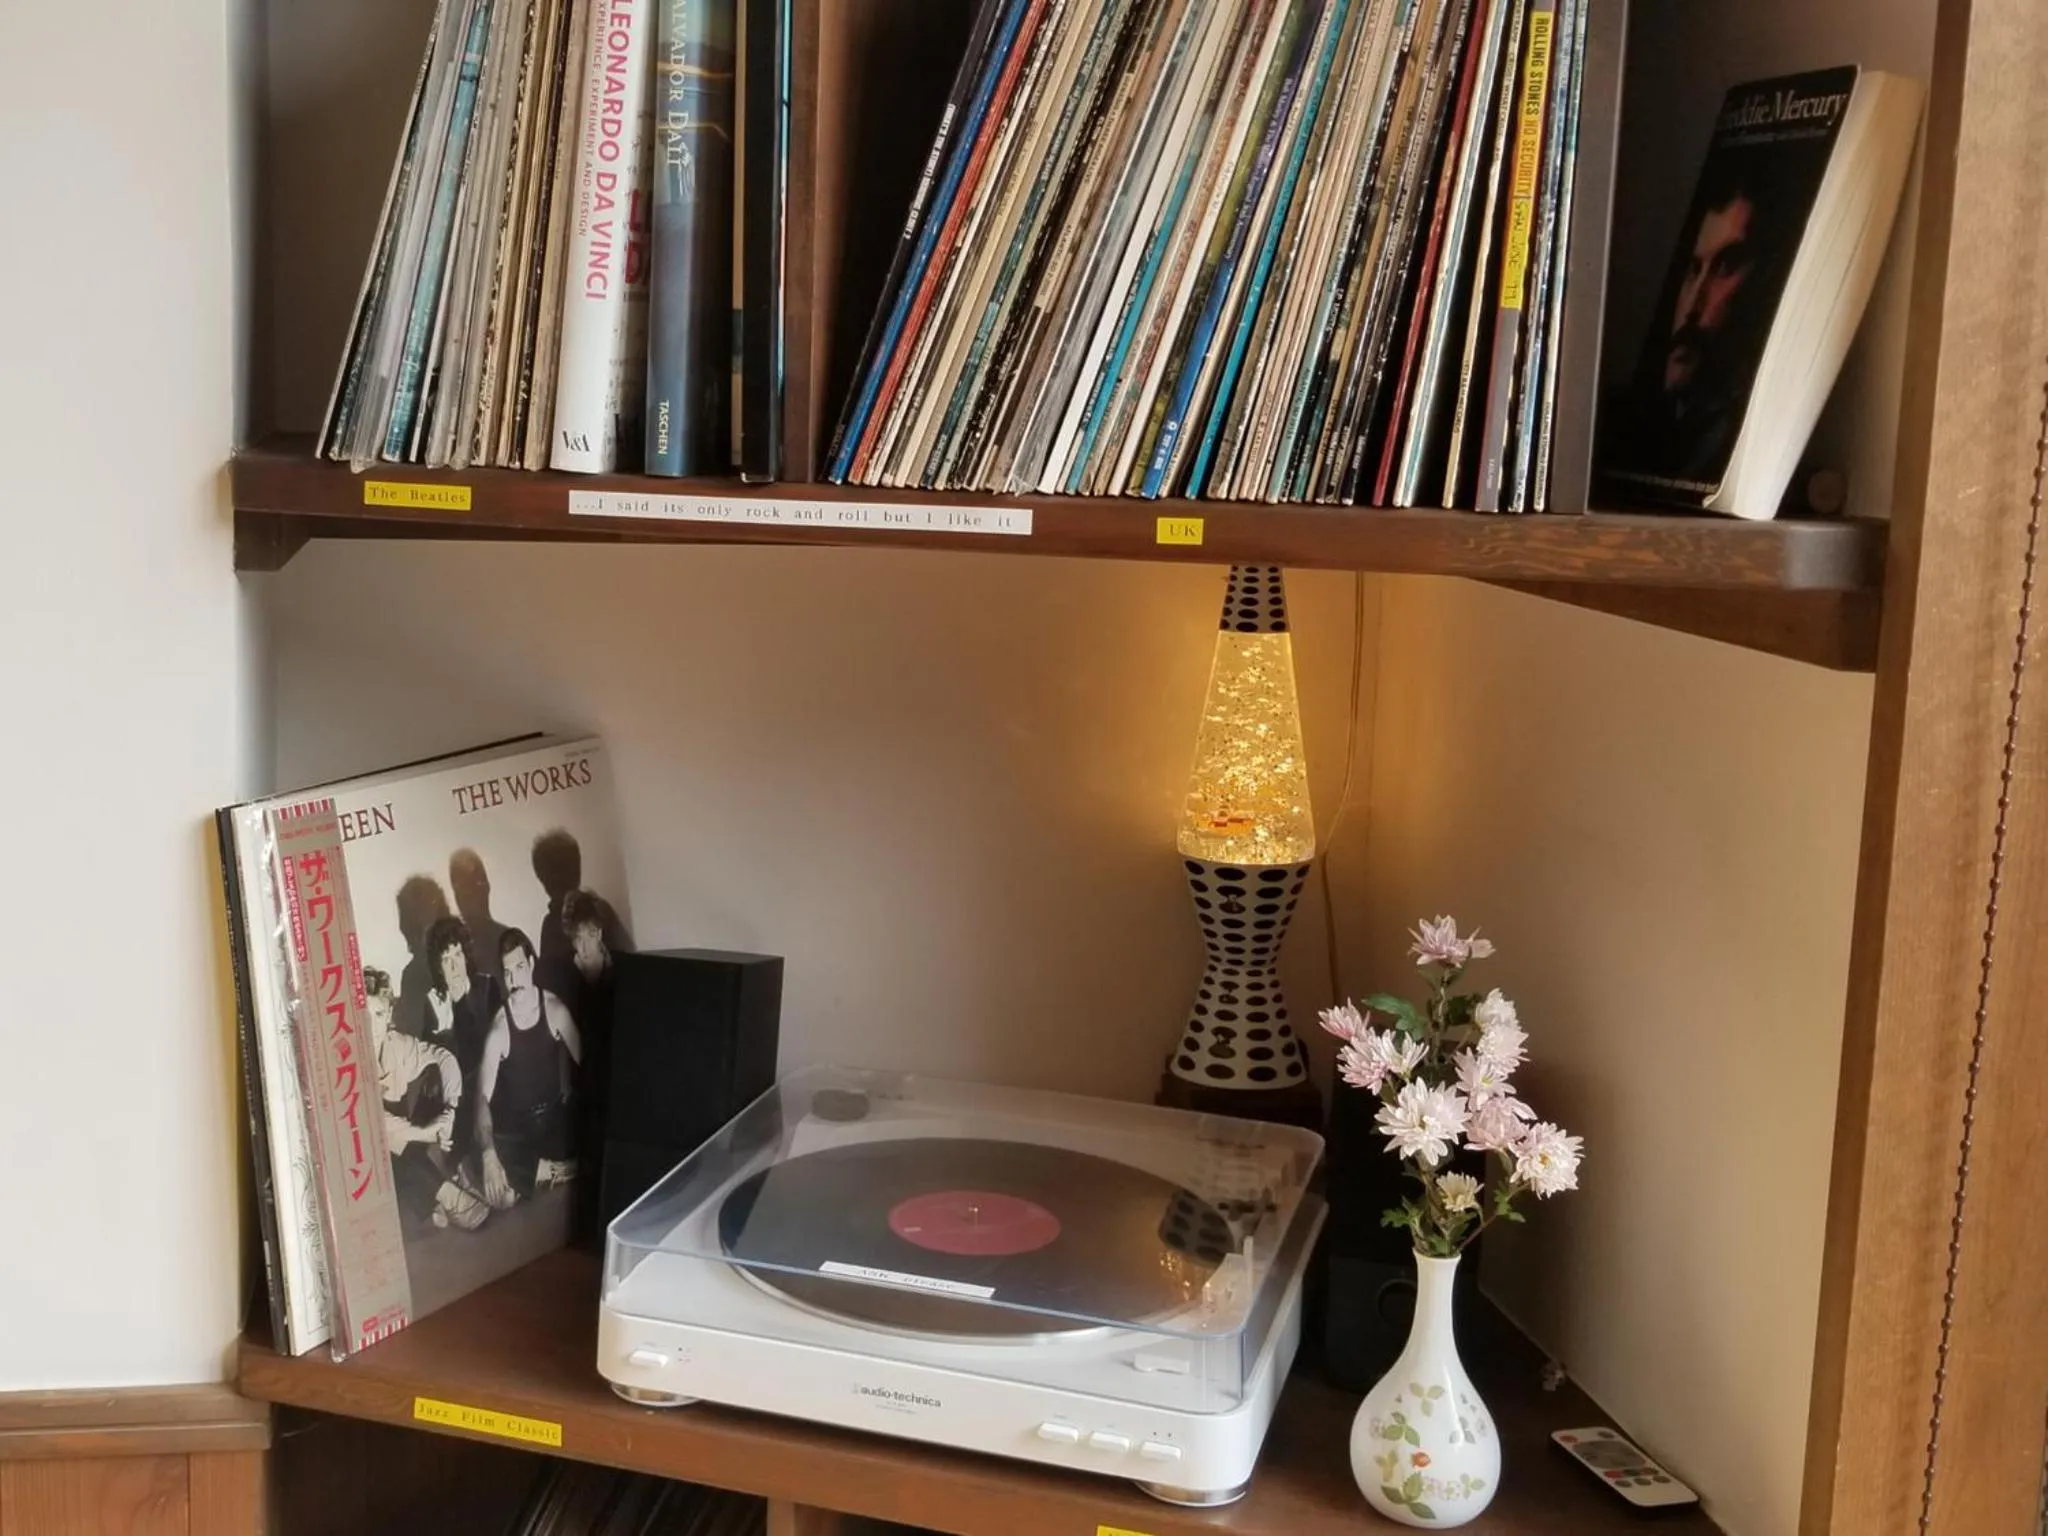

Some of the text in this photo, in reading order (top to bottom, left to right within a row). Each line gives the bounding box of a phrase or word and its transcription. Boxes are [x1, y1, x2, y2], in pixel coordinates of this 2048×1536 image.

[669, 0, 687, 105] ALVADOR
[587, 79, 601, 156] EXPERIMENT
[1518, 17, 1549, 197] ROLLING STONES NO SECURITY
[1771, 89, 1848, 126] Mercury
[585, 0, 632, 300] LEONARDO DA VINCI
[582, 162, 593, 187] AND
[578, 189, 590, 237] DESIGN
[657, 400, 670, 455] TASCHEN
[368, 486, 467, 503] The Beatles
[617, 500, 649, 512] said
[663, 502, 684, 514] its
[697, 504, 732, 518] only
[745, 506, 780, 518] rock
[794, 507, 823, 520] and
[838, 510, 869, 522] roll
[884, 511, 911, 523] but
[948, 513, 982, 527] like
[998, 515, 1012, 527] it
[1168, 523, 1199, 537] UK
[452, 758, 592, 815] THE WORKS
[337, 801, 397, 843] EEN
[300, 850, 354, 1040] ザ・ワークス
[336, 1062, 373, 1201] クイーン
[860, 1384, 942, 1409] audio-technica
[417, 1403, 559, 1440] Jazz Film Classic
